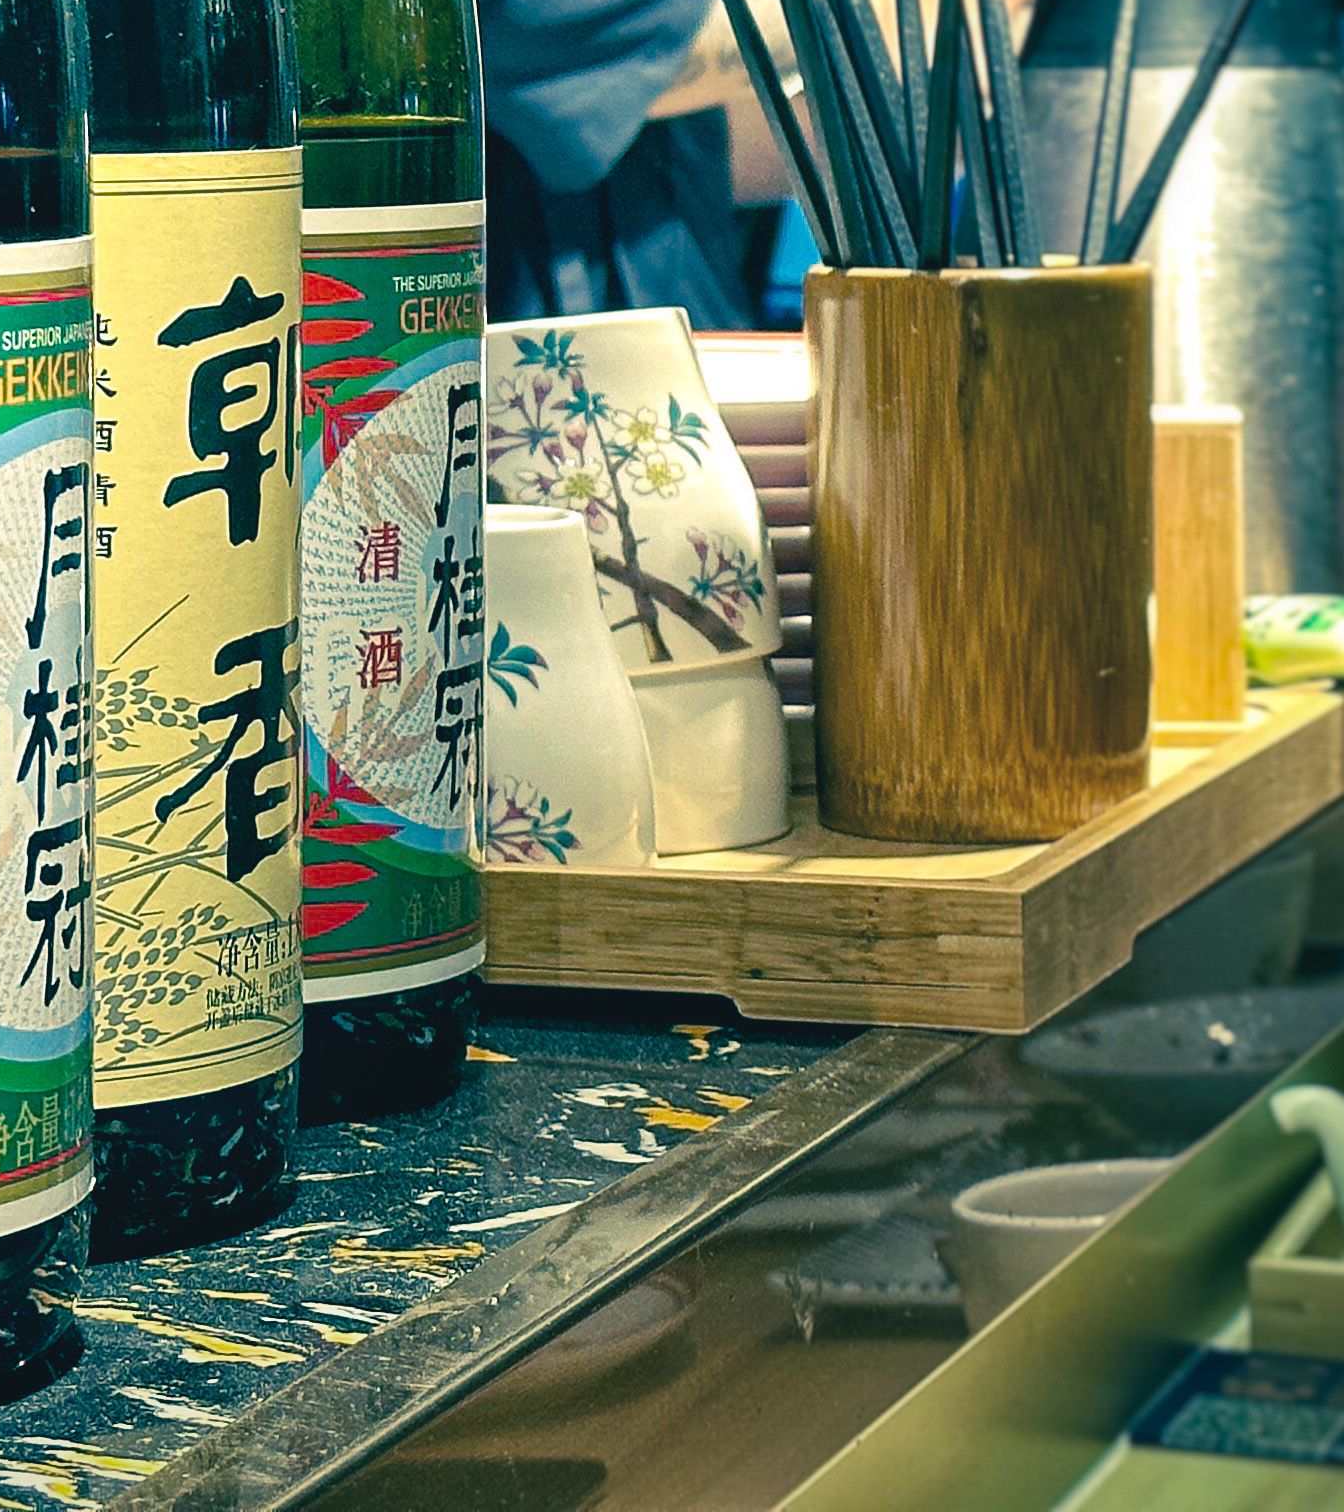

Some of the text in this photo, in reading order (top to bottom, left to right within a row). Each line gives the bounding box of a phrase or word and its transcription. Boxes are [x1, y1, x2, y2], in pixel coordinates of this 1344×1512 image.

[392, 276, 416, 292] THE
[417, 272, 462, 291] SUPERIOR
[2, 326, 62, 351] SUPERIOR
[355, 520, 404, 689] 清酒
[16, 461, 93, 1008] 月桂冠
